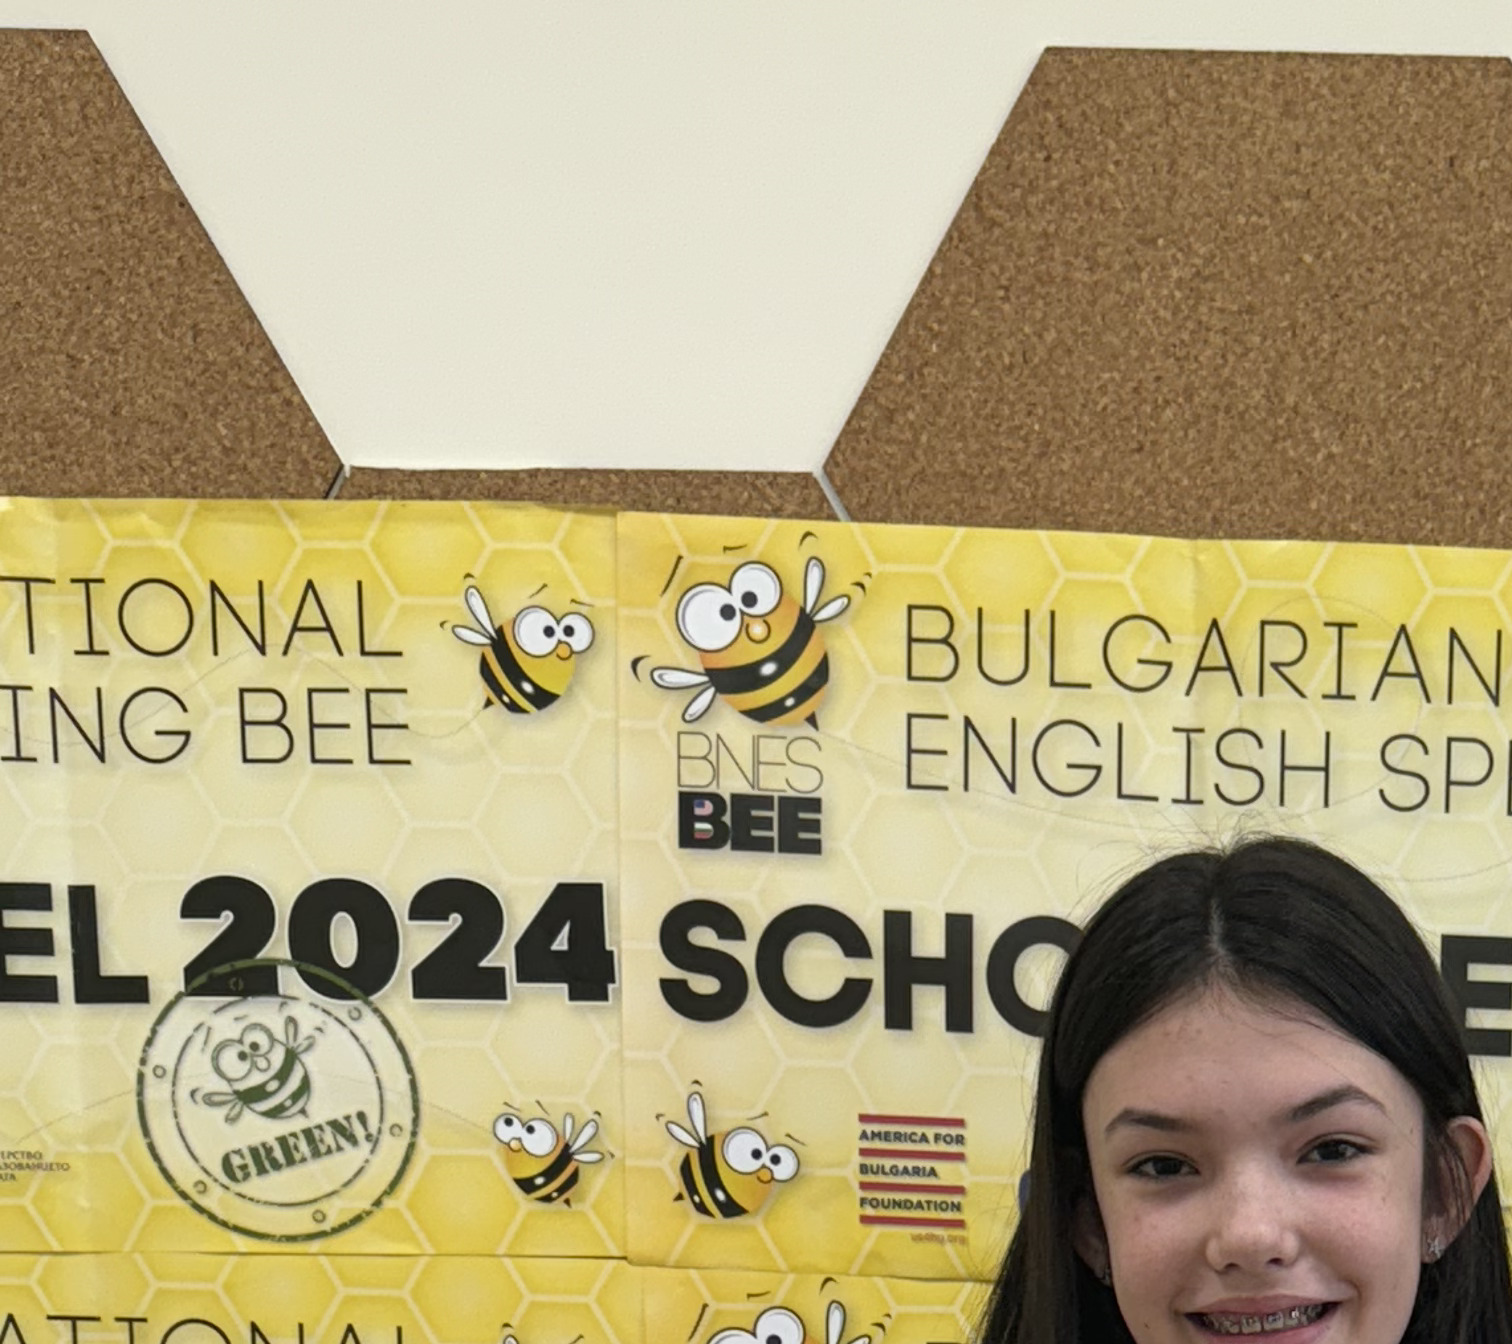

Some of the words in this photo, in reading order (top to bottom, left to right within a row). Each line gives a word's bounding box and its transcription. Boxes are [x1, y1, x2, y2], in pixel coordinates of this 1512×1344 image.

[906, 604, 1503, 707] BULGARIAN
[240, 688, 411, 765] BEE
[677, 730, 824, 794] BNES
[906, 712, 1331, 808] ENGLISH
[677, 790, 823, 855] BEE
[179, 875, 616, 1004] 2024
[659, 898, 1084, 1038] SCHO
[221, 1110, 376, 1184] GREEN!
[859, 1129, 930, 1145] AMERICA
[934, 1132, 965, 1146] FOR
[859, 1163, 937, 1178] BULGARIA
[860, 1197, 962, 1213] FOUNDATION
